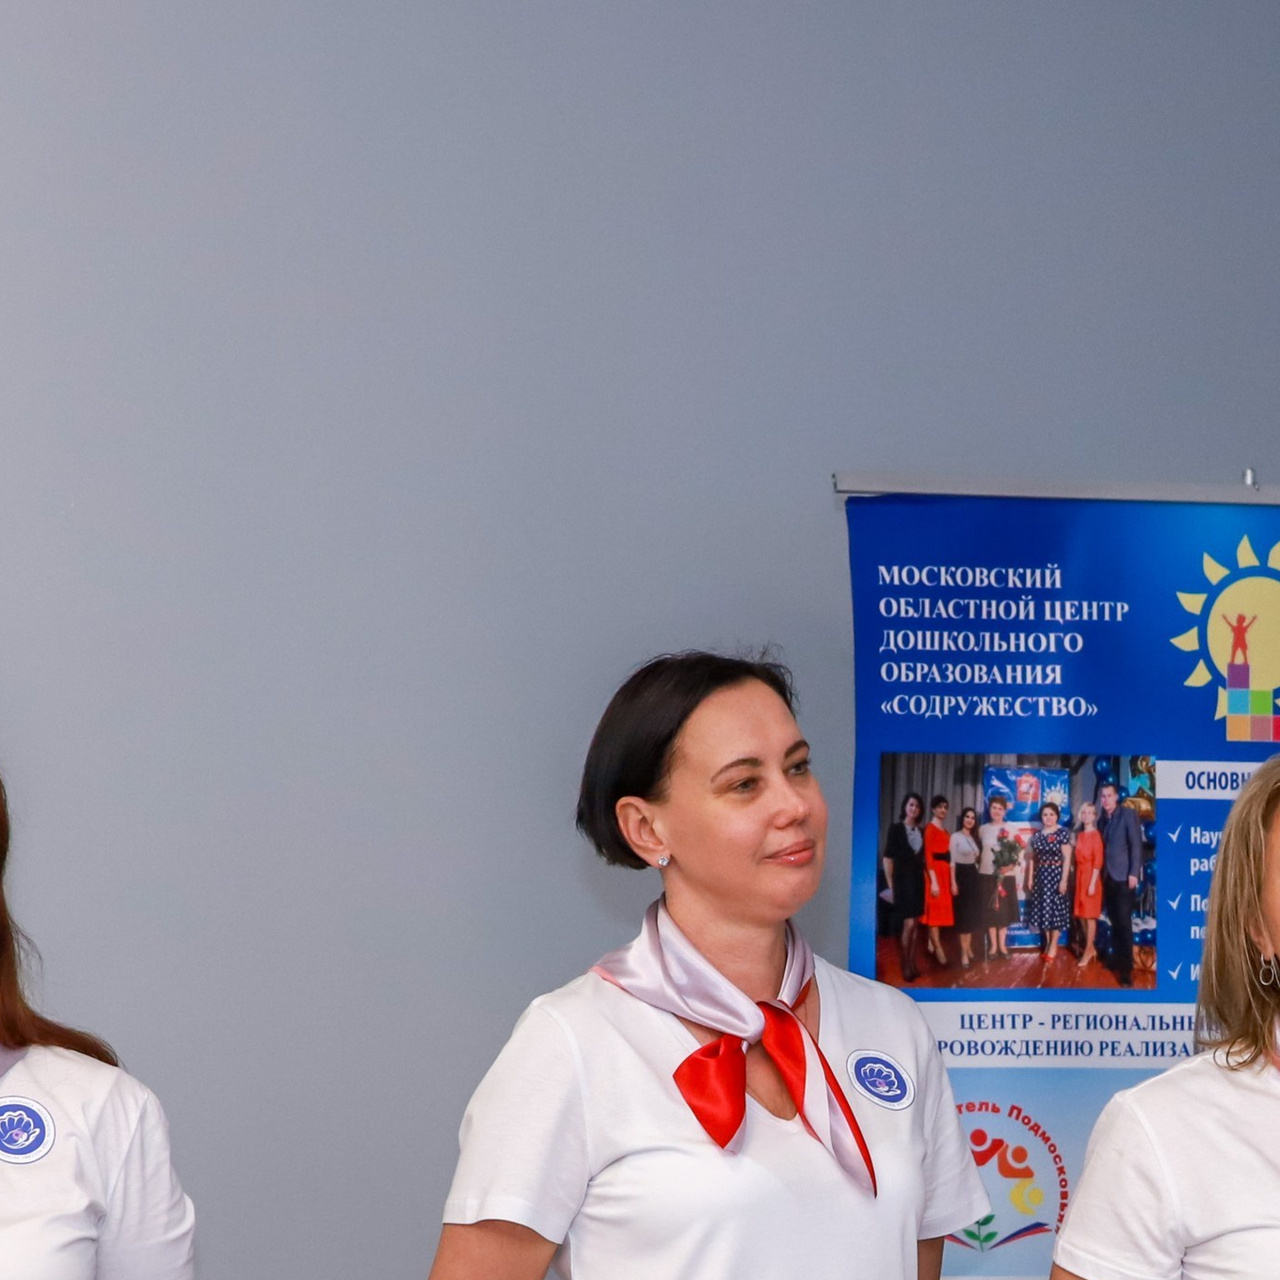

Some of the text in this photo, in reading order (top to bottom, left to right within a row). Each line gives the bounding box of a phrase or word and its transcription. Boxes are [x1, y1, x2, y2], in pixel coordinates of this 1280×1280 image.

[877, 563, 1062, 588] МОСКОВСКИЙ
[878, 595, 1129, 624] ОБЛАСТНОЙ ЦЕНТР
[879, 629, 1084, 653] ДОШКОЛЬНОГО
[880, 661, 1062, 685] ОБРАЗОВАНИЯ
[880, 694, 1099, 719] «СОДРУЖЕСТВО»
[960, 1013, 1033, 1033] ЦЕНТР
